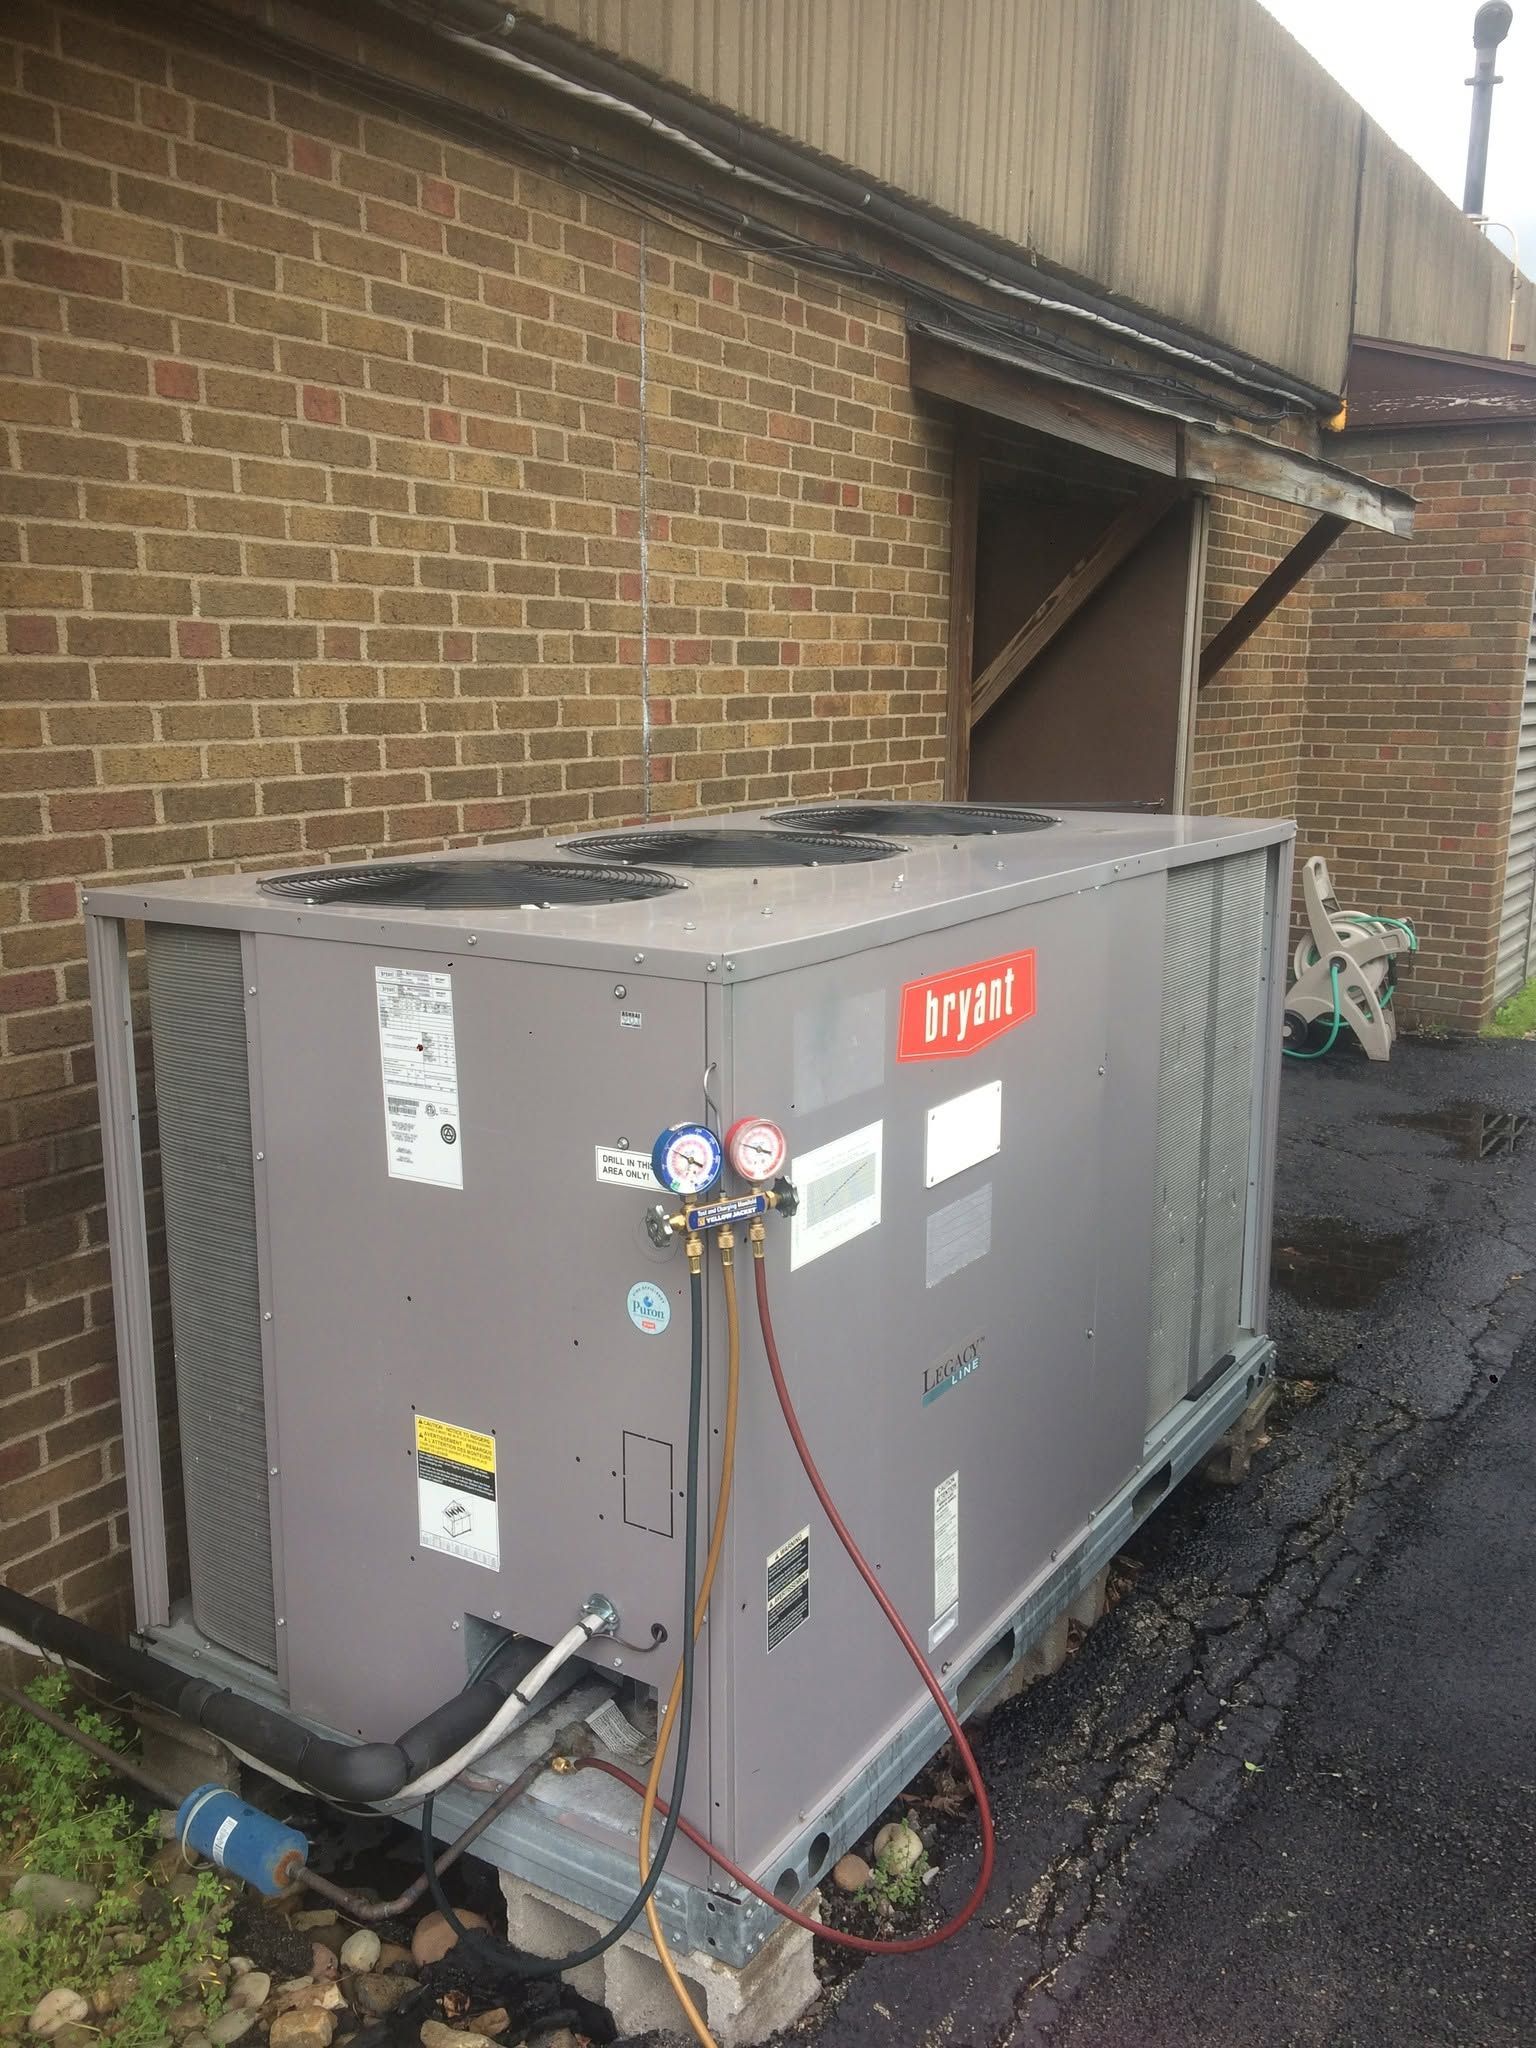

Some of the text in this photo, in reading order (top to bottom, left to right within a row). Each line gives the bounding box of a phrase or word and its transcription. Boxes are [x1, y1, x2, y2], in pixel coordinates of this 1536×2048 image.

[925, 967, 1015, 1043] bryant
[603, 1155, 624, 1166] DRILL
[627, 1158, 635, 1168] IN
[602, 1166, 649, 1181] AREA ONLY!
[706, 1206, 757, 1223] YELLOW JACKET
[632, 1300, 665, 1319] Puron
[921, 1343, 978, 1396] LEGACY
[951, 1357, 979, 1385] LINE
